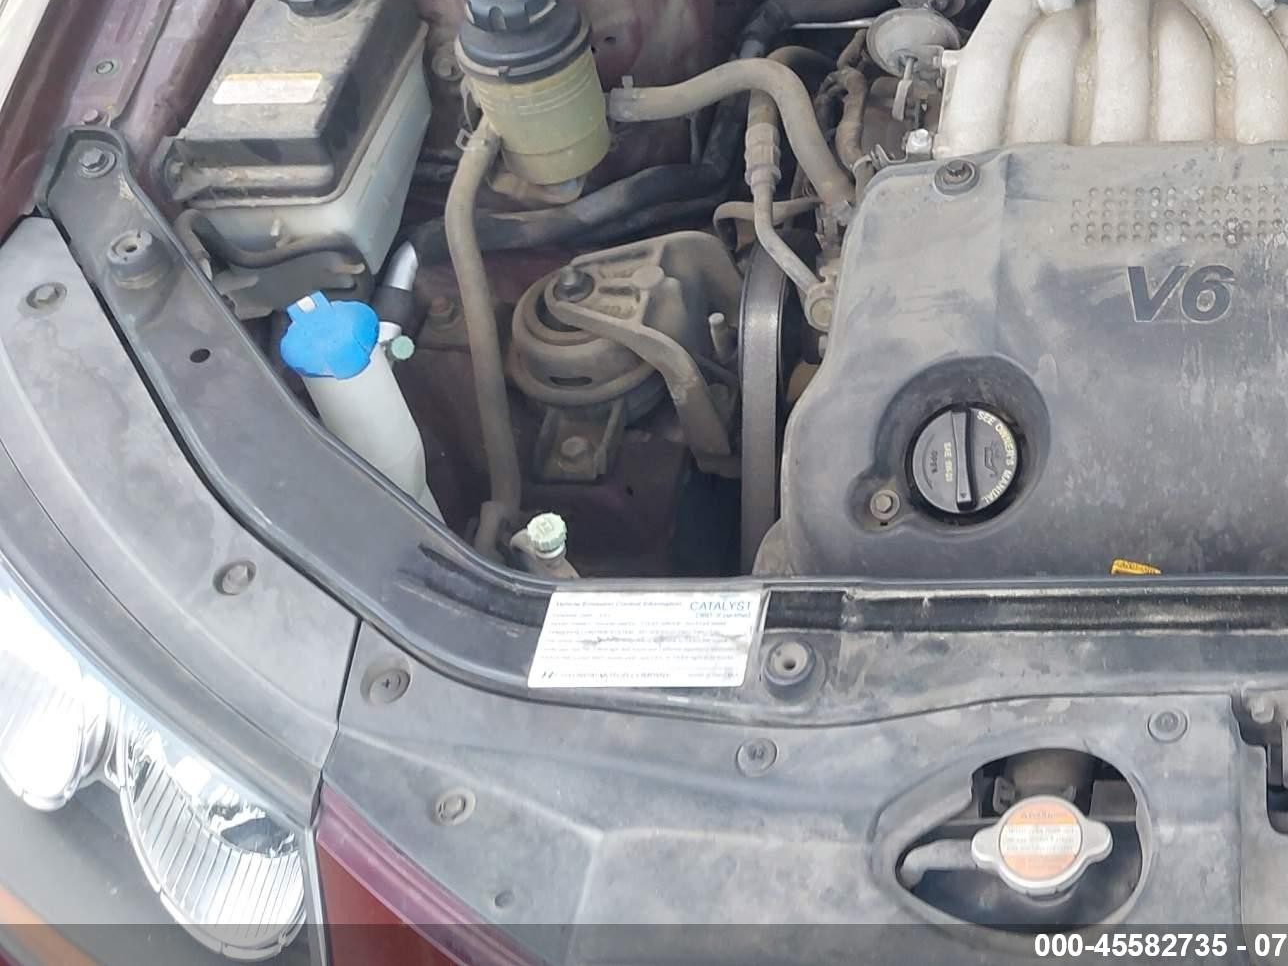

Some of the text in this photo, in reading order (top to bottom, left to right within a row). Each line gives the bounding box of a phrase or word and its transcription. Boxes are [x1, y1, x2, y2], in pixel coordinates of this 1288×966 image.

[1127, 264, 1235, 323] V6
[977, 410, 996, 426] SEE
[981, 469, 1013, 504] MANUAL
[690, 600, 752, 612] CATALYST
